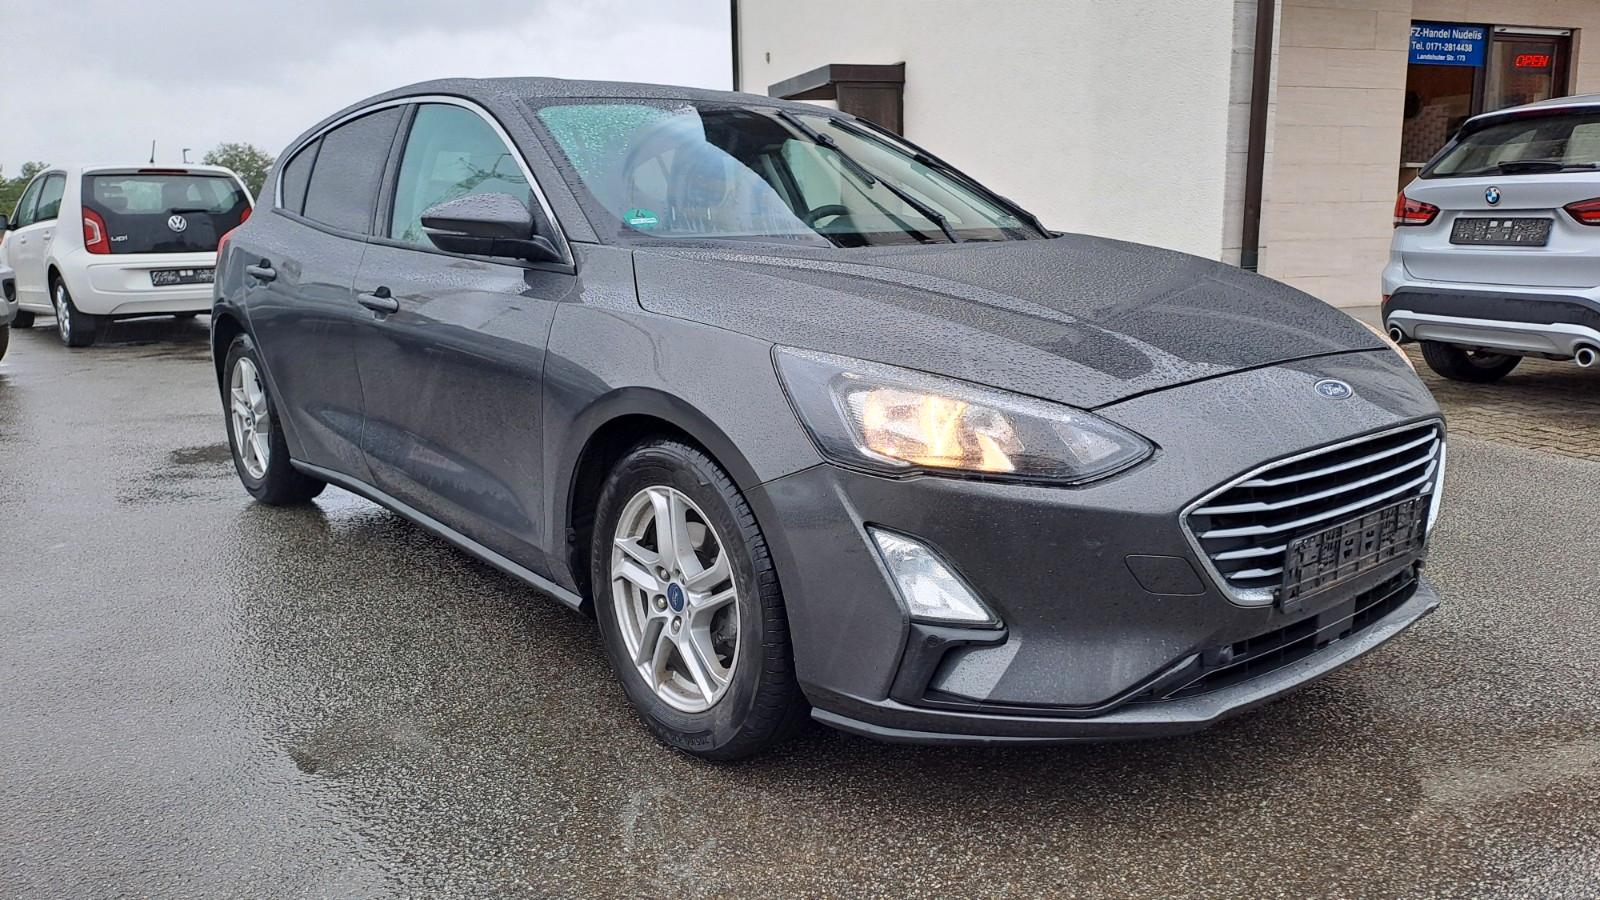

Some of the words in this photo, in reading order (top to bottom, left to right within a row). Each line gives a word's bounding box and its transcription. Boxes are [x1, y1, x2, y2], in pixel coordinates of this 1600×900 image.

[1452, 30, 1482, 40] Nudelis
[1411, 41, 1425, 50] Tel.
[1426, 42, 1472, 52] 0171-2814438
[1514, 54, 1550, 67] OPEN
